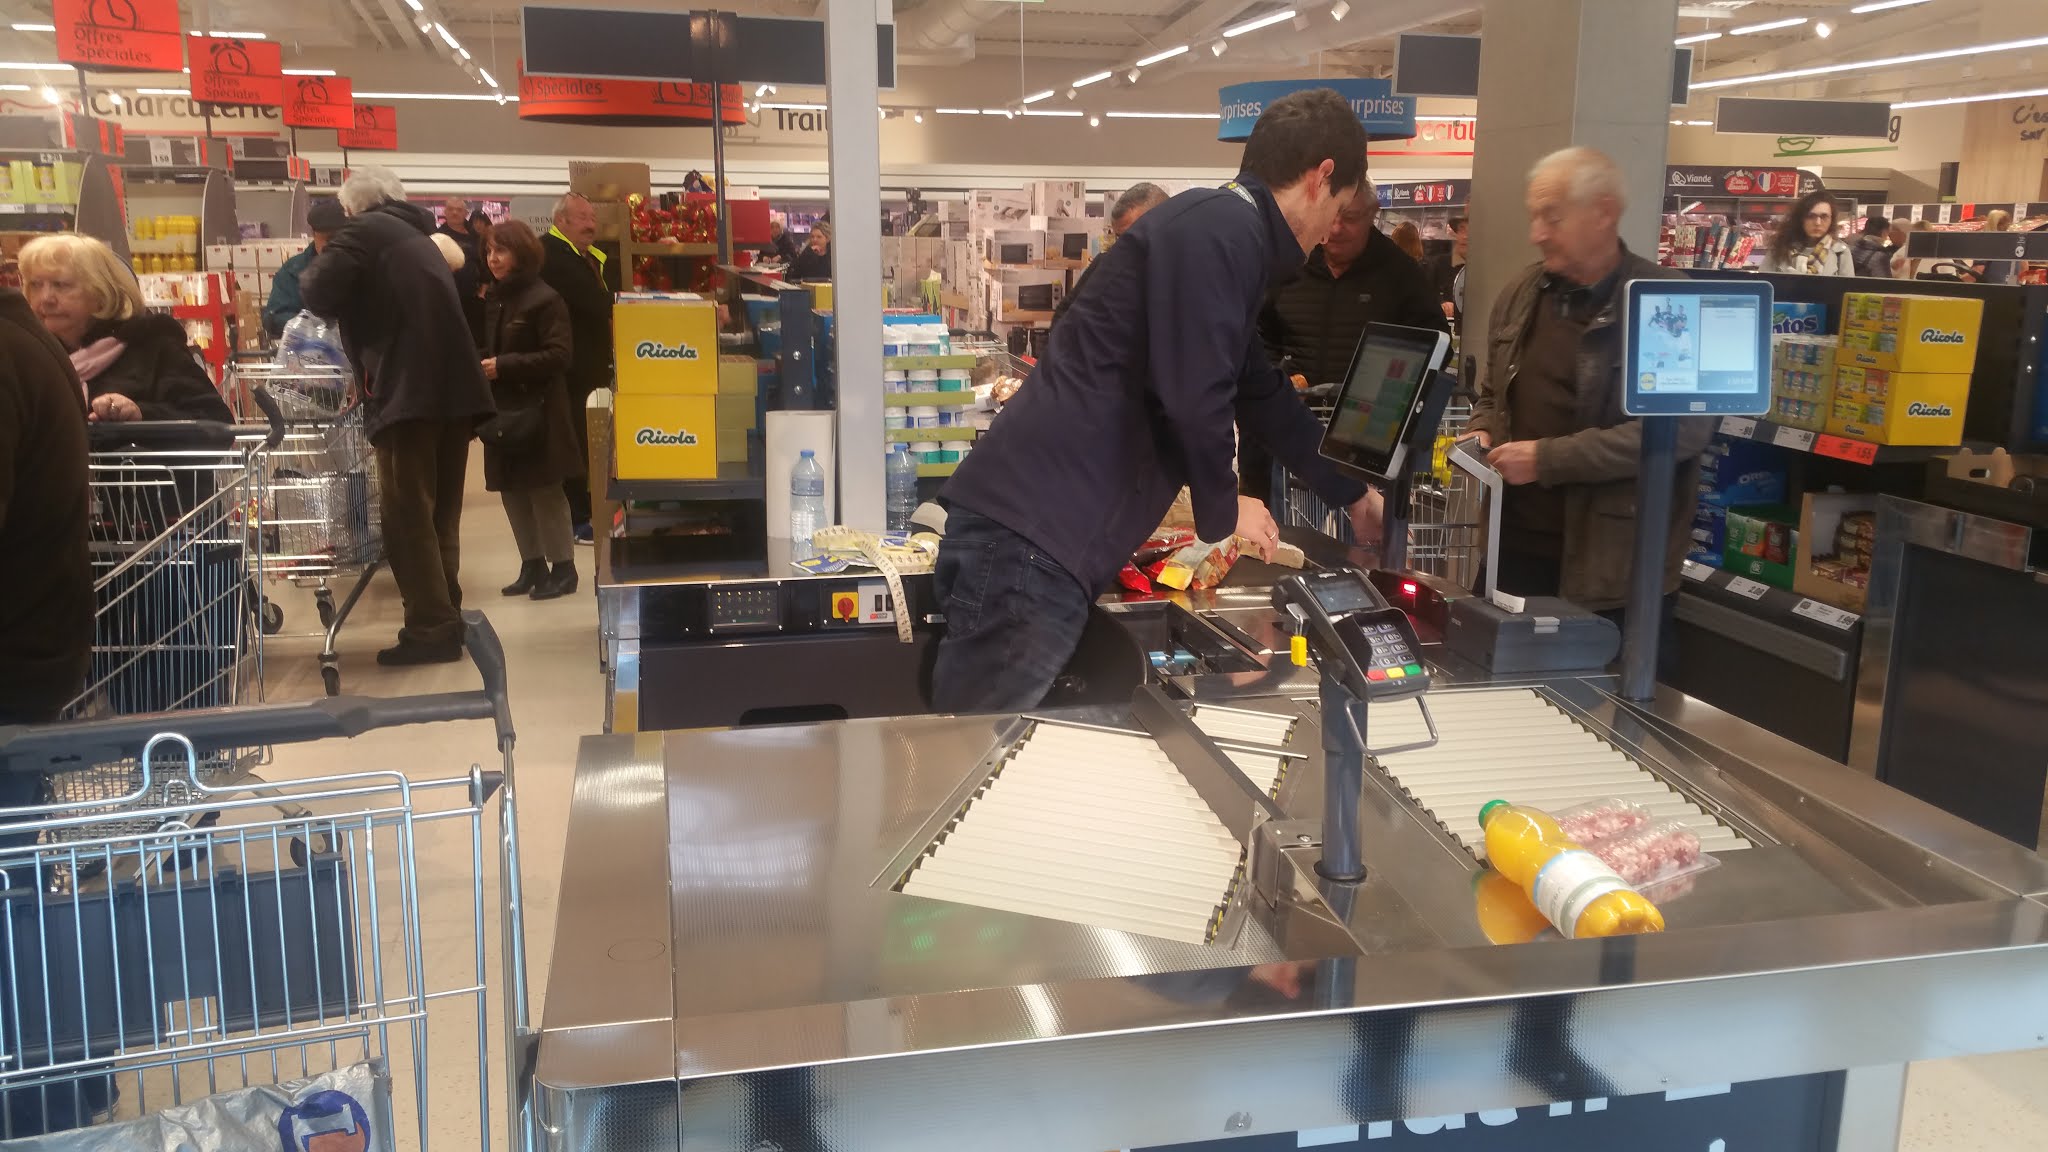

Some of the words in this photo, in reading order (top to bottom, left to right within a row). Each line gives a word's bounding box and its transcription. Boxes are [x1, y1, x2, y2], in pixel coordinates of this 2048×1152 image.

[74, 28, 123, 45] Offres
[1686, 174, 1712, 184] Viande
[1921, 328, 1964, 344] Ricola
[636, 341, 698, 361] Ricola
[1907, 402, 1952, 417] Ricola
[636, 428, 697, 446] Ricola
